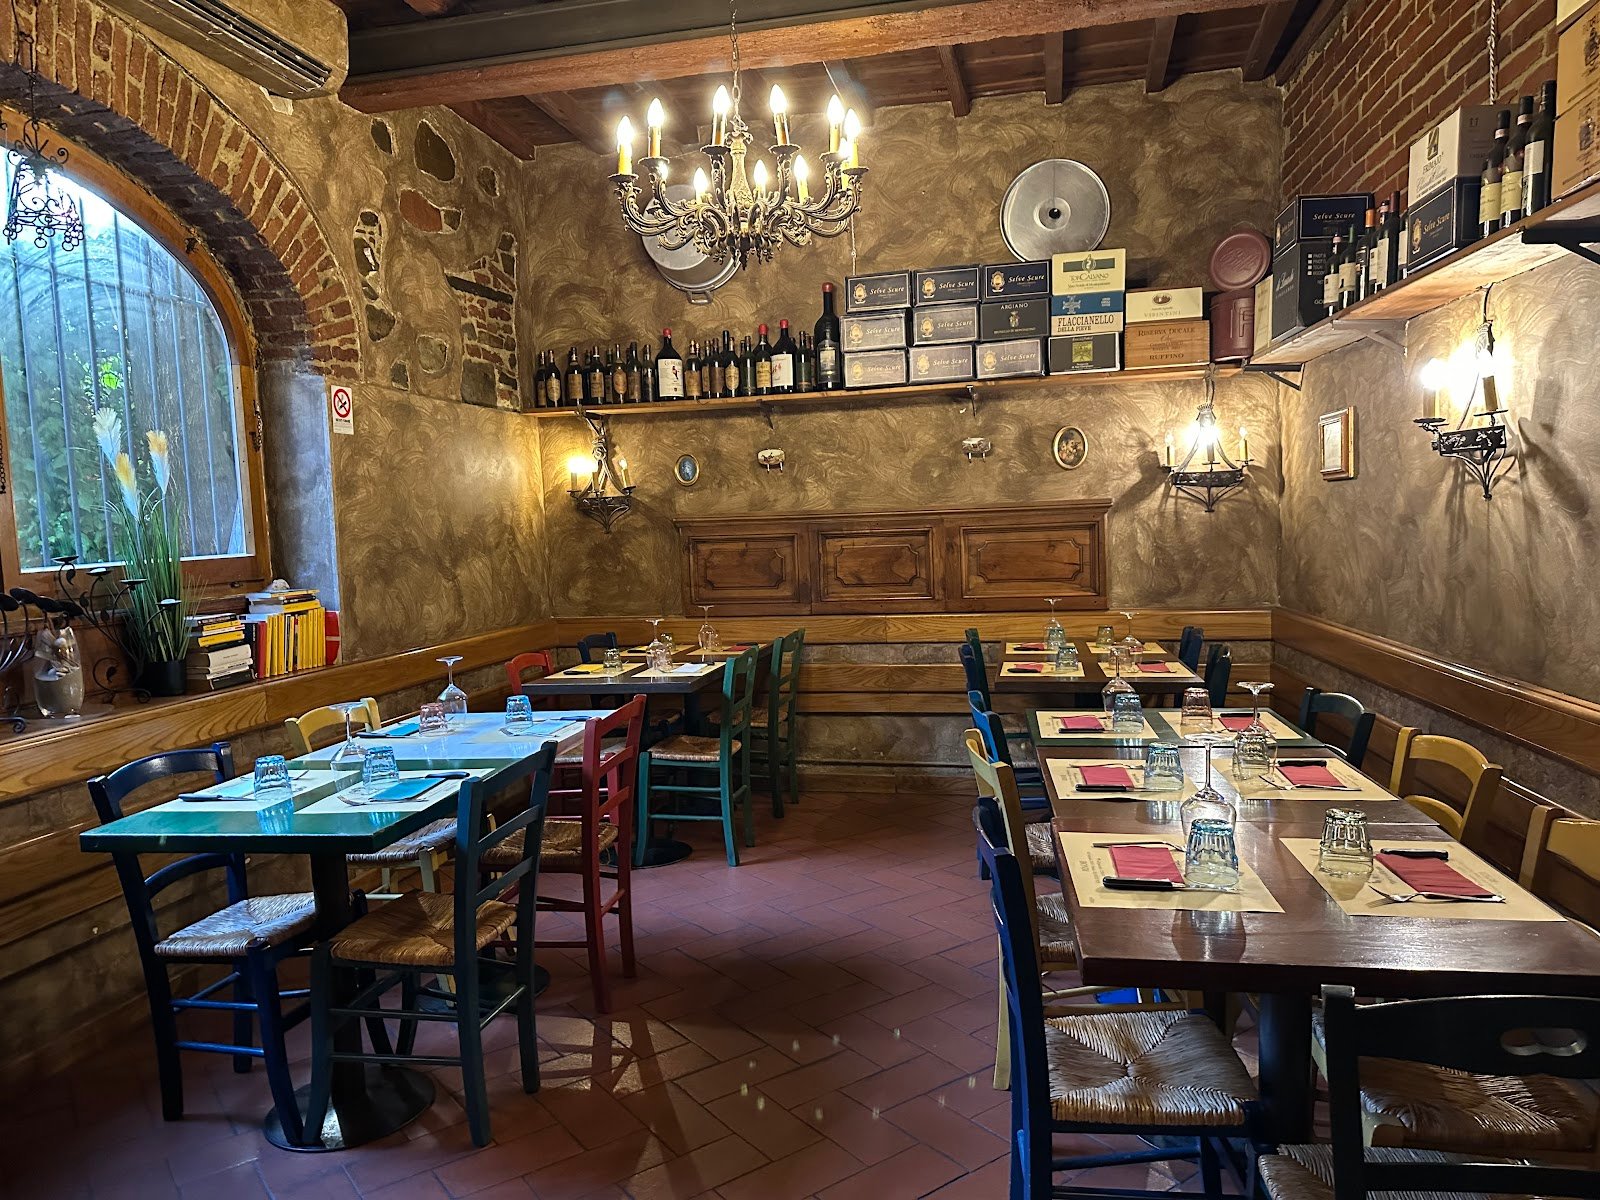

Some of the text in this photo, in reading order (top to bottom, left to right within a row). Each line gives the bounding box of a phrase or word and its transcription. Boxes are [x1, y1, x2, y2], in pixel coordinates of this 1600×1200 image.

[1312, 212, 1333, 221] Selve
[1000, 302, 1029, 310] ARGIANO
[1058, 314, 1114, 327] FLACCIANELLO
[1138, 327, 1196, 337] RISERVA DUCALE
